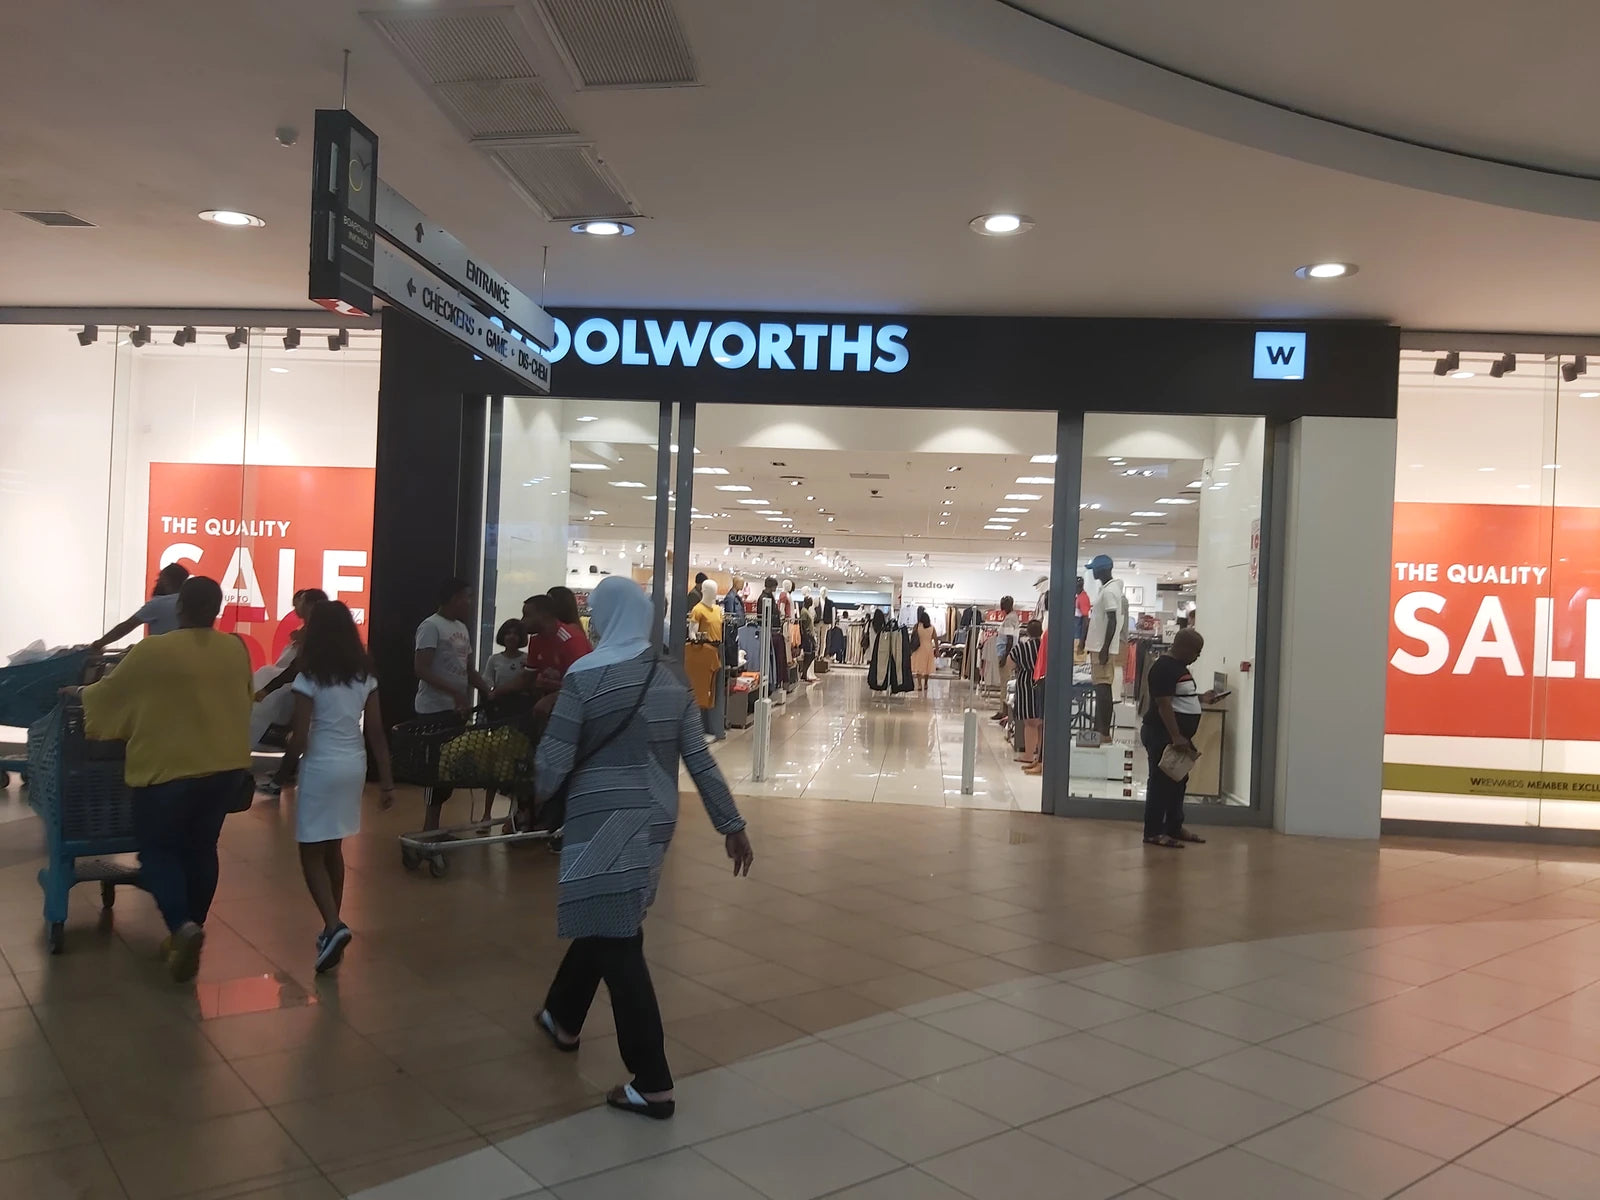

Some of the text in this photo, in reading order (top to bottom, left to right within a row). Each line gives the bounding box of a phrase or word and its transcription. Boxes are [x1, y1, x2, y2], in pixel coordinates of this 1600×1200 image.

[466, 260, 510, 309] ENTRANCE
[422, 287, 548, 383] CHECKERS GAME DIS-CHEM
[161, 516, 291, 537] THE QUALITY
[729, 535, 800, 545] CUSTOMER SERVICES
[1394, 562, 1548, 585] THE QUALITY
[224, 594, 249, 603] UP TO
[1527, 780, 1569, 791] MEMBER
